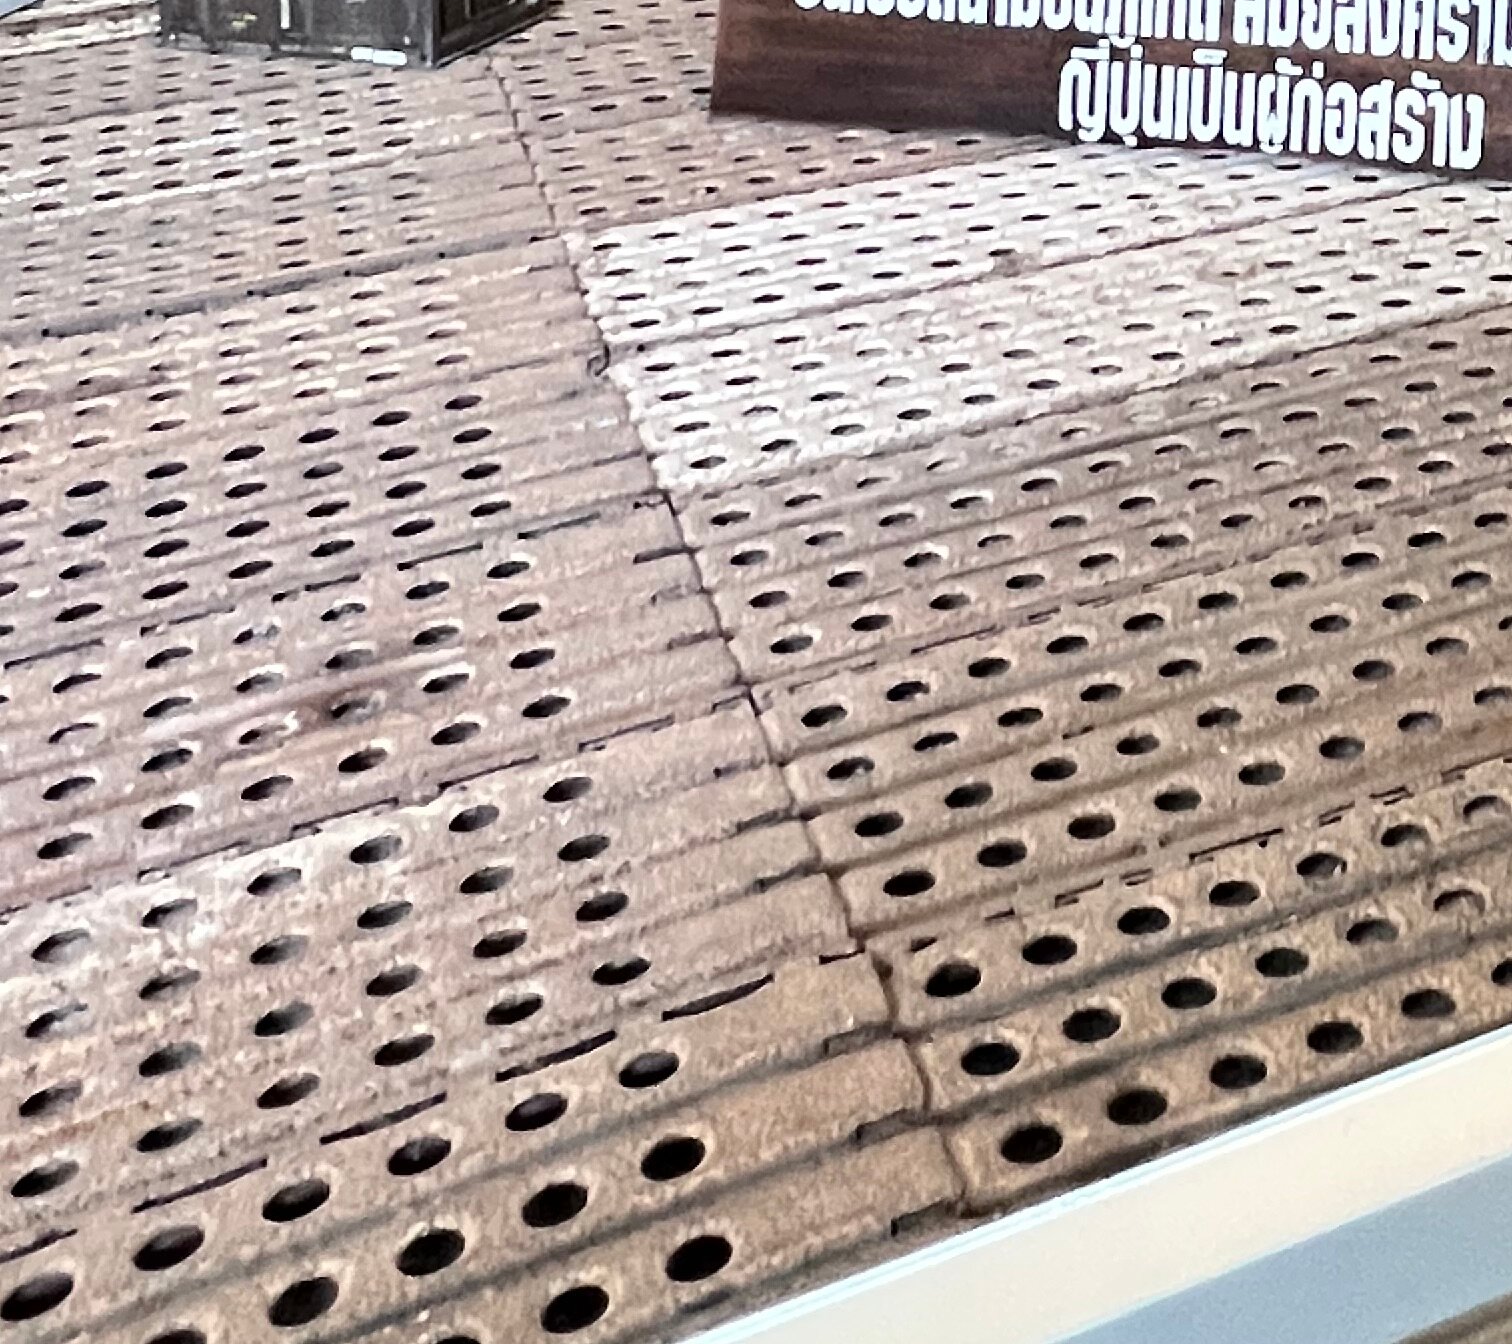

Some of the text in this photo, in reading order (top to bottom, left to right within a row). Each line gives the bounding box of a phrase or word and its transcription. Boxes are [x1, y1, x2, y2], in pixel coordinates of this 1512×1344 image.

[1058, 40, 1486, 172] ญี่ปุ่นเป็นผู้ก่อสร้าง
